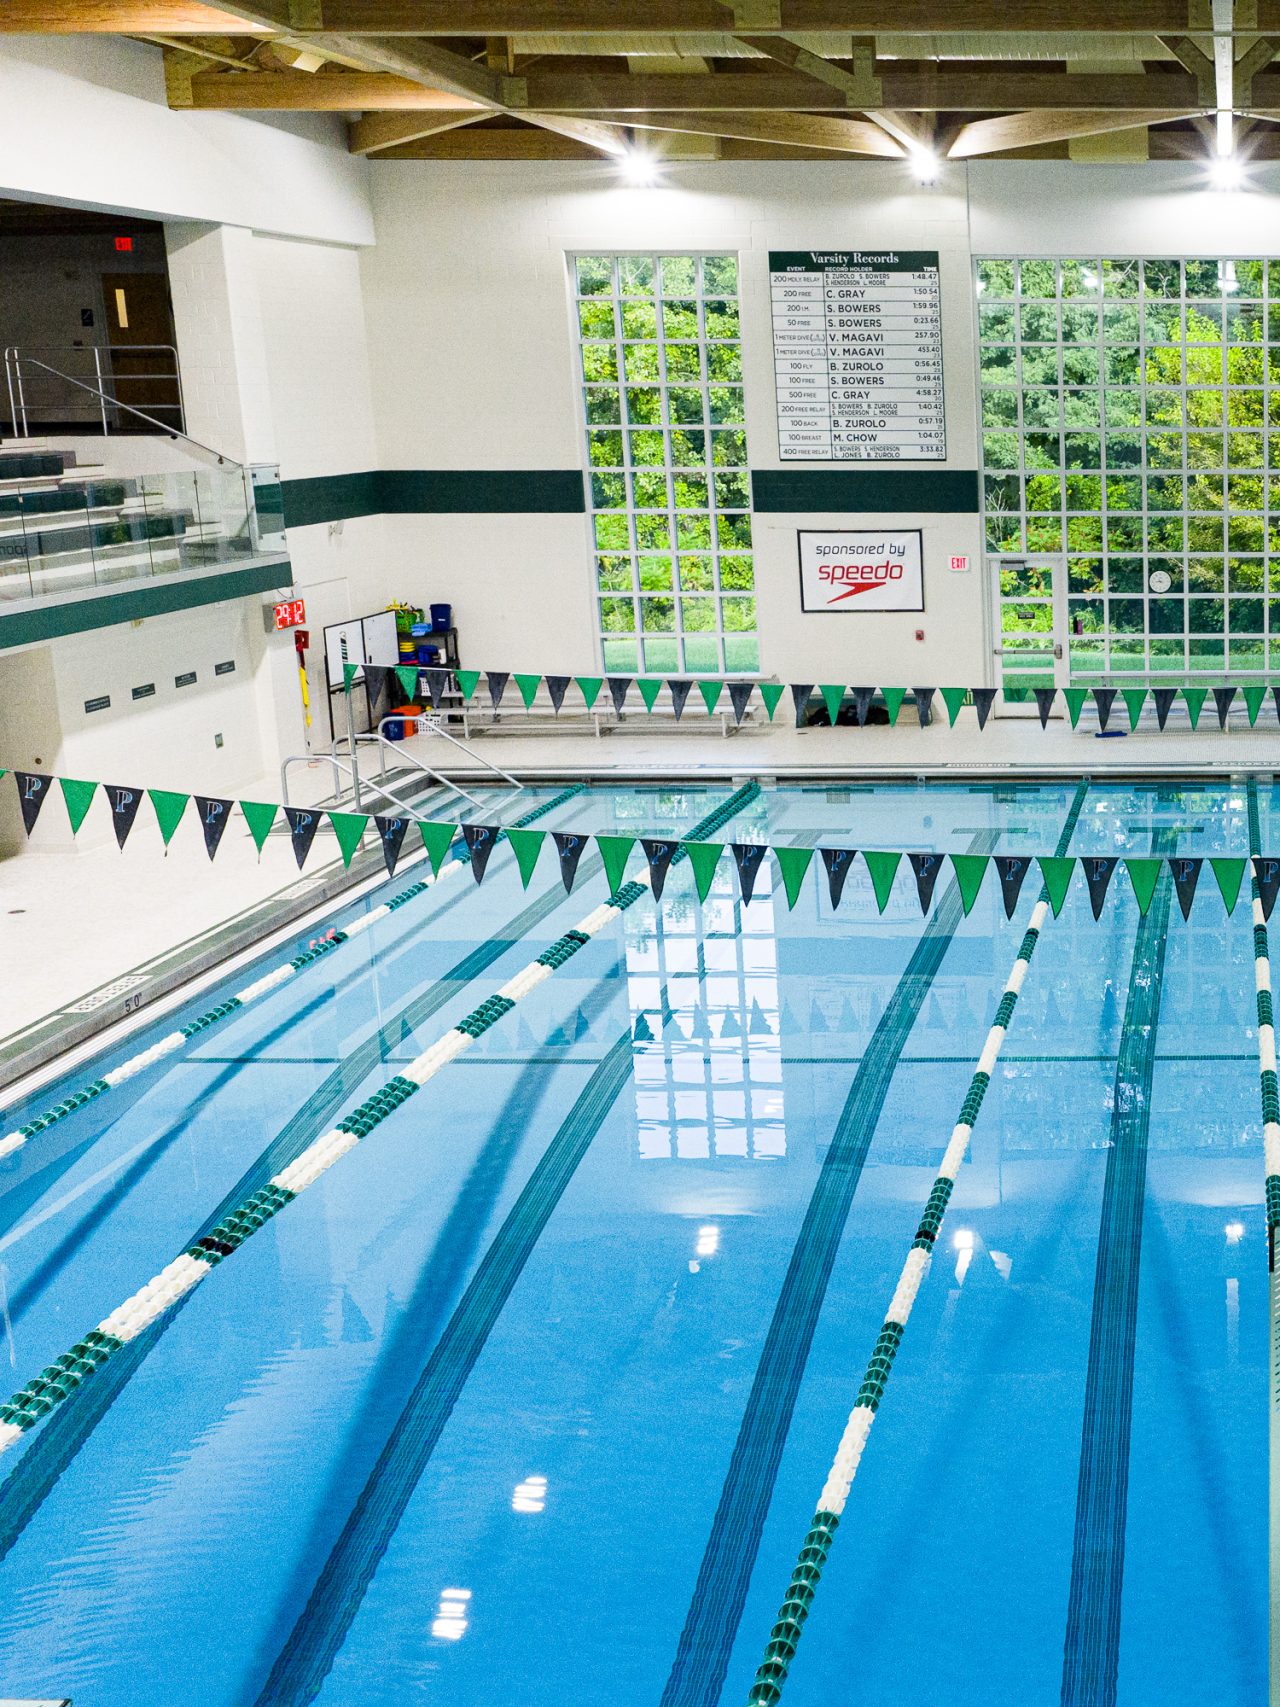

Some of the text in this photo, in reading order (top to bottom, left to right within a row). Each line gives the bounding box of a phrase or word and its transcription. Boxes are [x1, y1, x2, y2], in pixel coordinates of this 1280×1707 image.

[811, 253, 899, 266] Varsity Records
[827, 290, 865, 298] C. GRAY
[828, 319, 882, 327] S. BOWERS
[842, 333, 883, 341] MAGAVI
[830, 348, 840, 356] V.
[843, 348, 884, 356] MAGAVI
[832, 391, 870, 399] C. GRAY
[834, 434, 877, 442] M. CHOW
[816, 543, 905, 556] sponsored by
[952, 558, 966, 569] EXIT
[819, 561, 903, 584] speedo
[276, 602, 303, 628] 29:12
